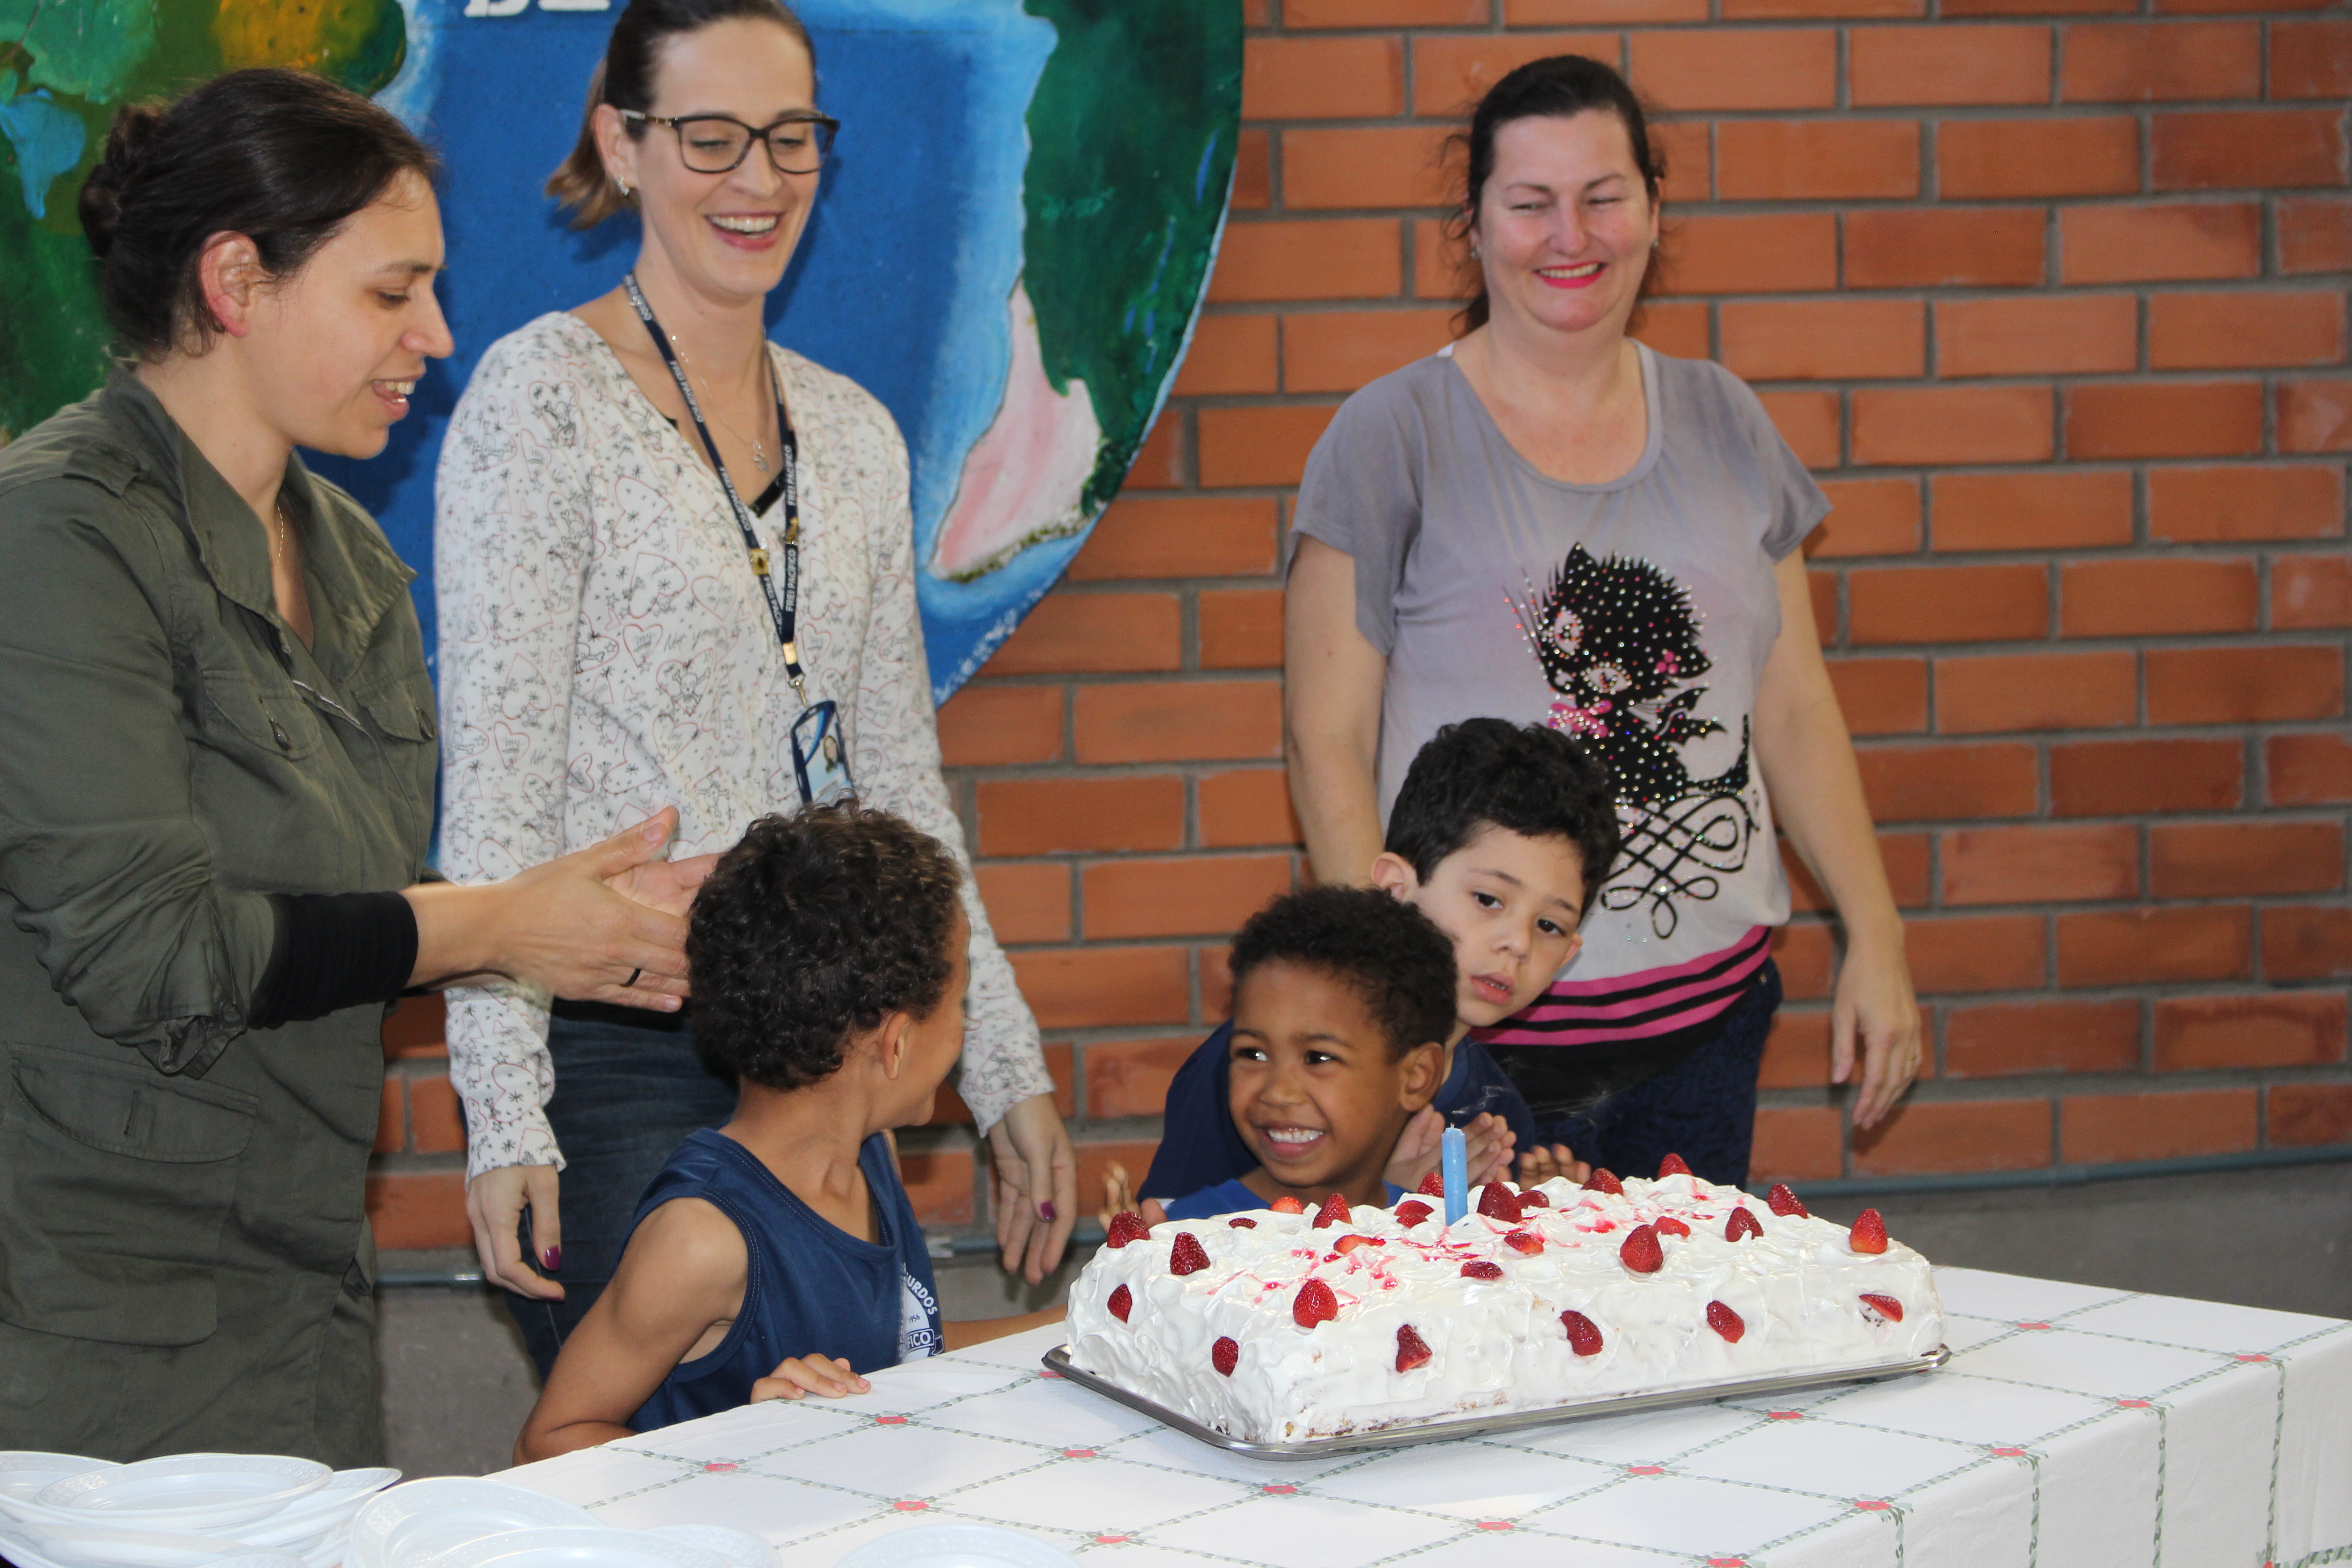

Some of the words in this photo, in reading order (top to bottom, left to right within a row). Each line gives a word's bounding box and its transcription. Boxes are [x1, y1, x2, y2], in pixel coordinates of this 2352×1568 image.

[763, 577, 775, 599] FREI
[785, 589, 795, 612] FREI
[907, 1272, 938, 1315] URDOS
